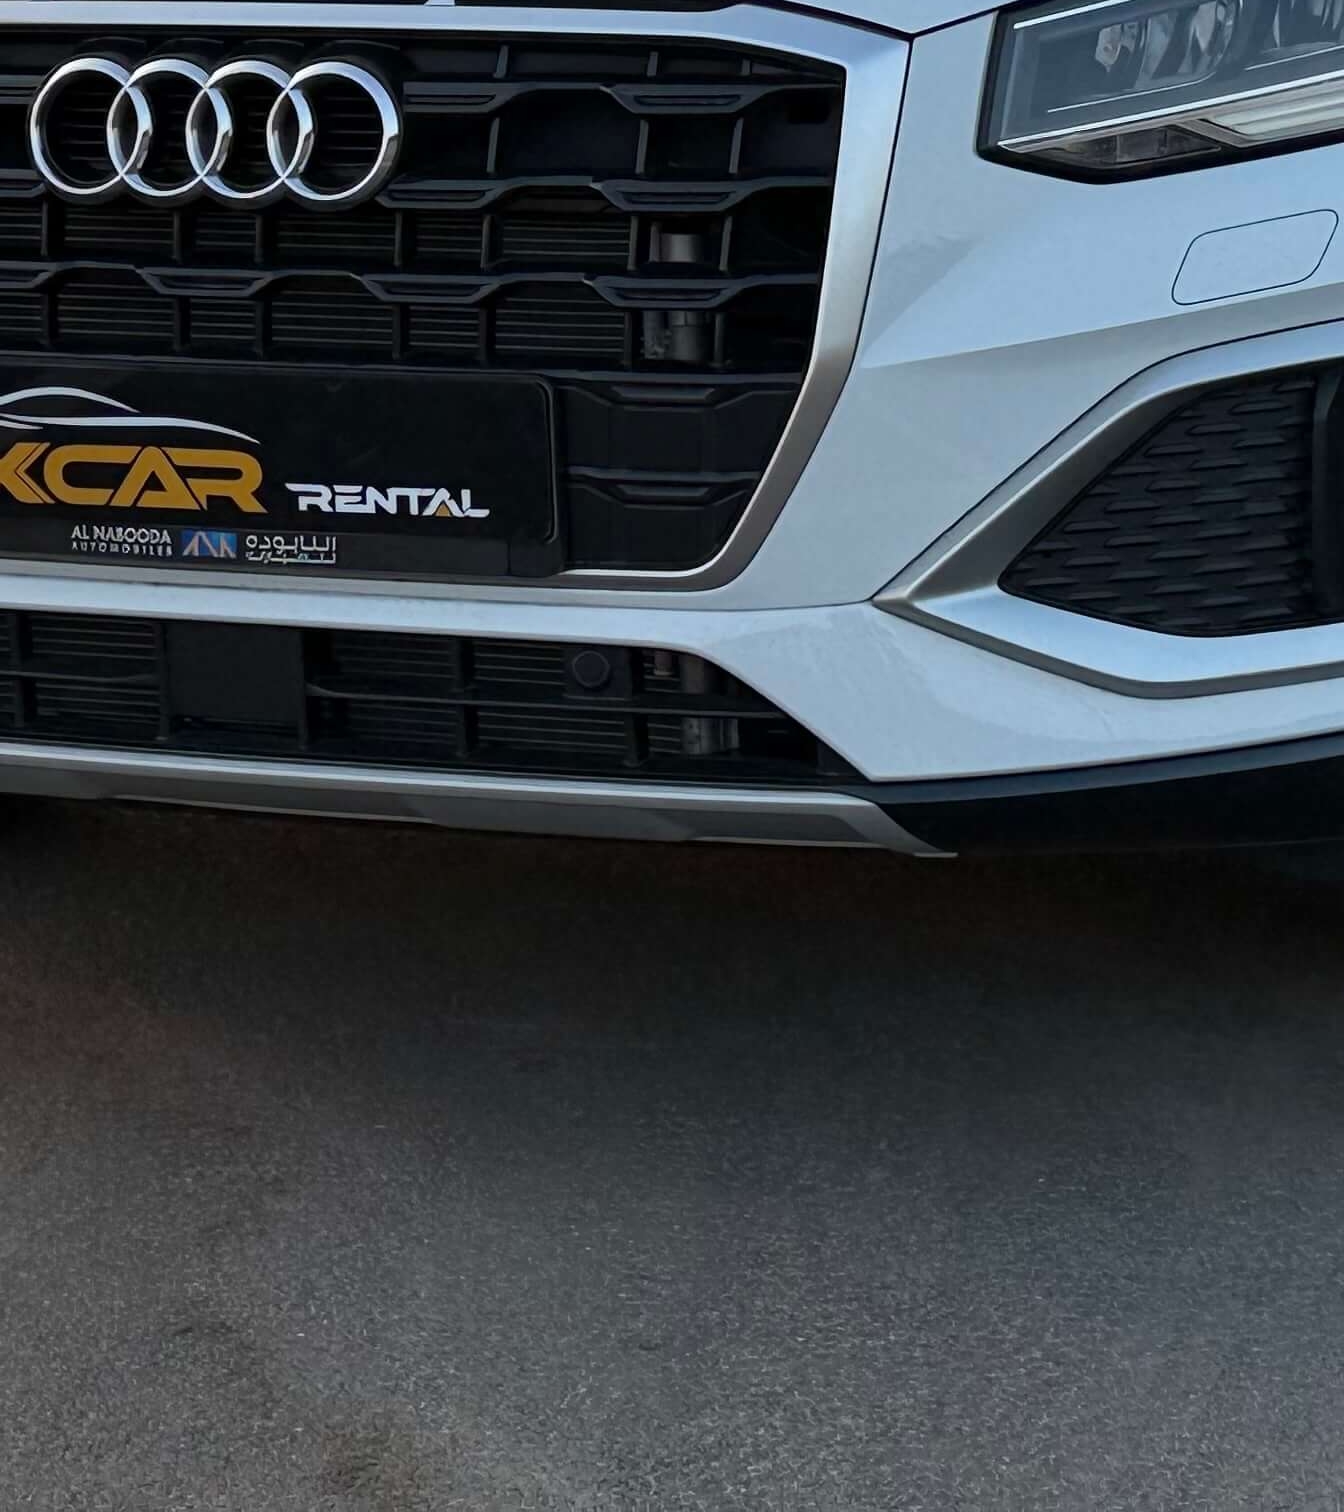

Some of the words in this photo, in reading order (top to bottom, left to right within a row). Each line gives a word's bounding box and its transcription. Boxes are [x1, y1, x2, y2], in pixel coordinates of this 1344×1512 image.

[285, 482, 491, 518] RENTAL
[71, 524, 90, 539] AL
[93, 525, 172, 544] NABOODA
